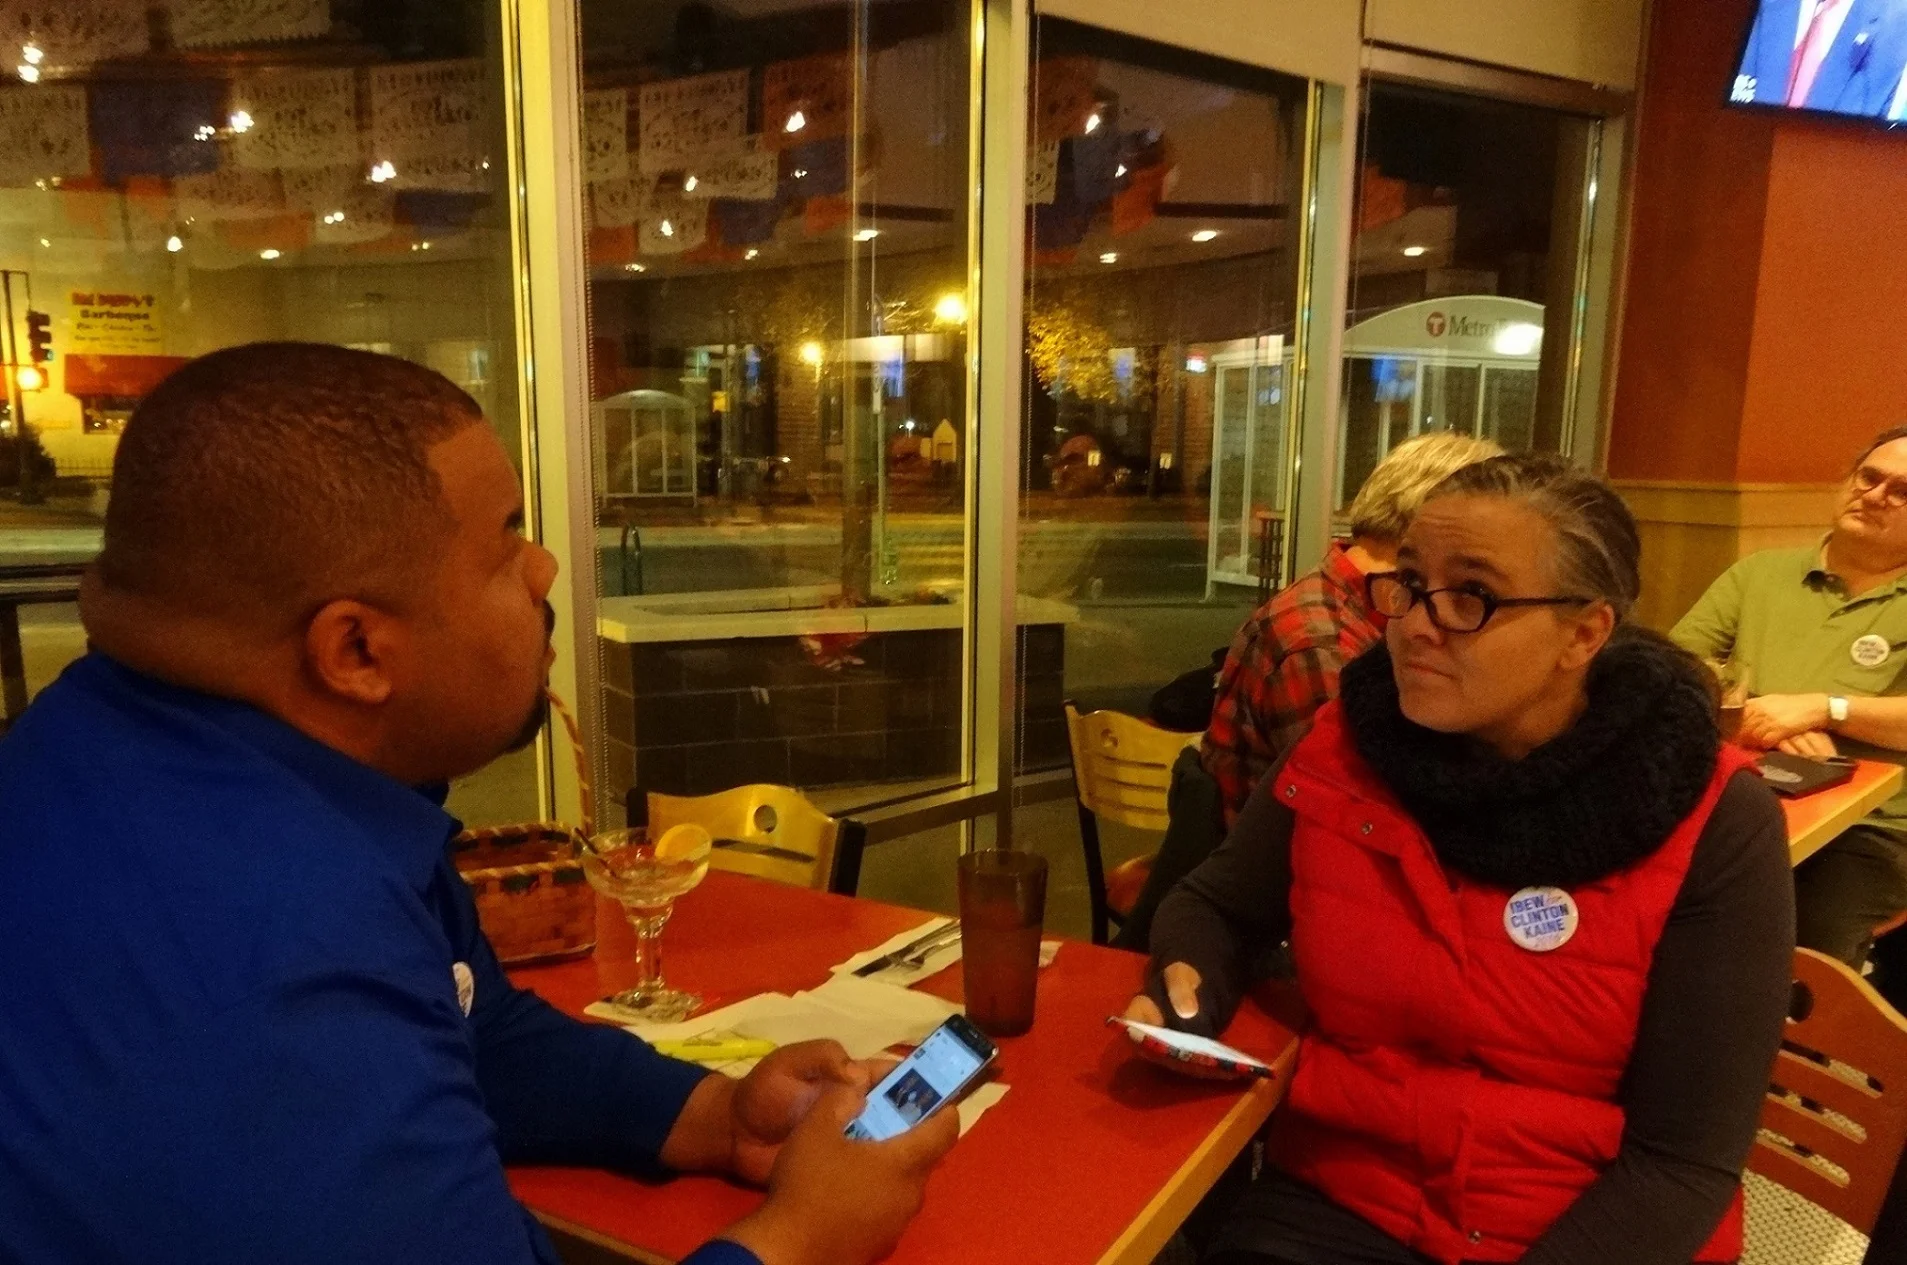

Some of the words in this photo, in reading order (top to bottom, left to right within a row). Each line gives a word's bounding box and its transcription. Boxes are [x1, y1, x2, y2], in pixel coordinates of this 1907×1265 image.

[1510, 895, 1544, 914] IBEW
[1511, 904, 1569, 928] CLINTON
[1524, 918, 1565, 939] KAINE
